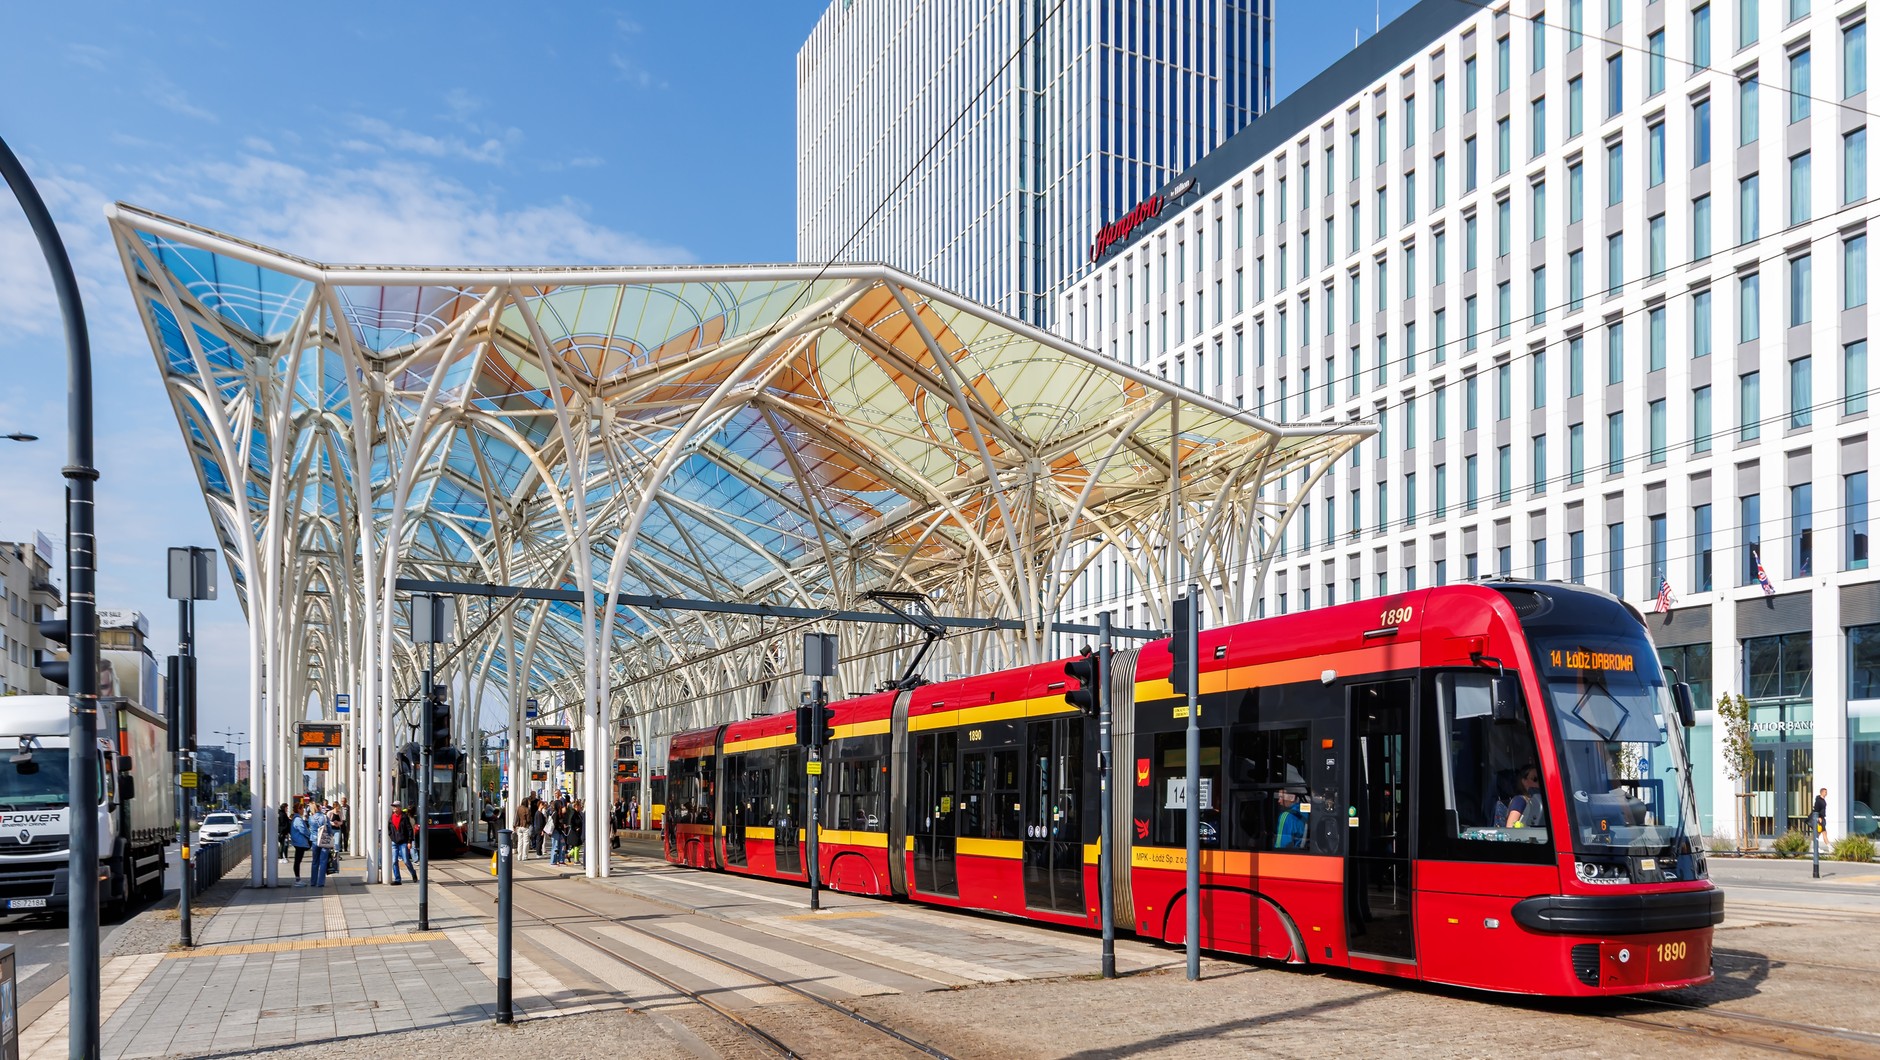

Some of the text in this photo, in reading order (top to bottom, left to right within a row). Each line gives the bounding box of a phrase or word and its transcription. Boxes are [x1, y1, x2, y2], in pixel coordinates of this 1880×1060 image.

[1175, 179, 1190, 195] Hilton
[1090, 195, 1164, 262] Hampton
[1380, 606, 1413, 626] 1890
[1550, 650, 1562, 667] 14
[1752, 720, 1786, 732] ALIOR
[968, 729, 982, 741] 1890
[1173, 786, 1186, 803] 14
[0, 814, 61, 823] POWER
[1601, 819, 1607, 831] 6
[1136, 852, 1149, 861] MPK
[12, 900, 21, 908] BS
[1656, 941, 1687, 962] 1890
